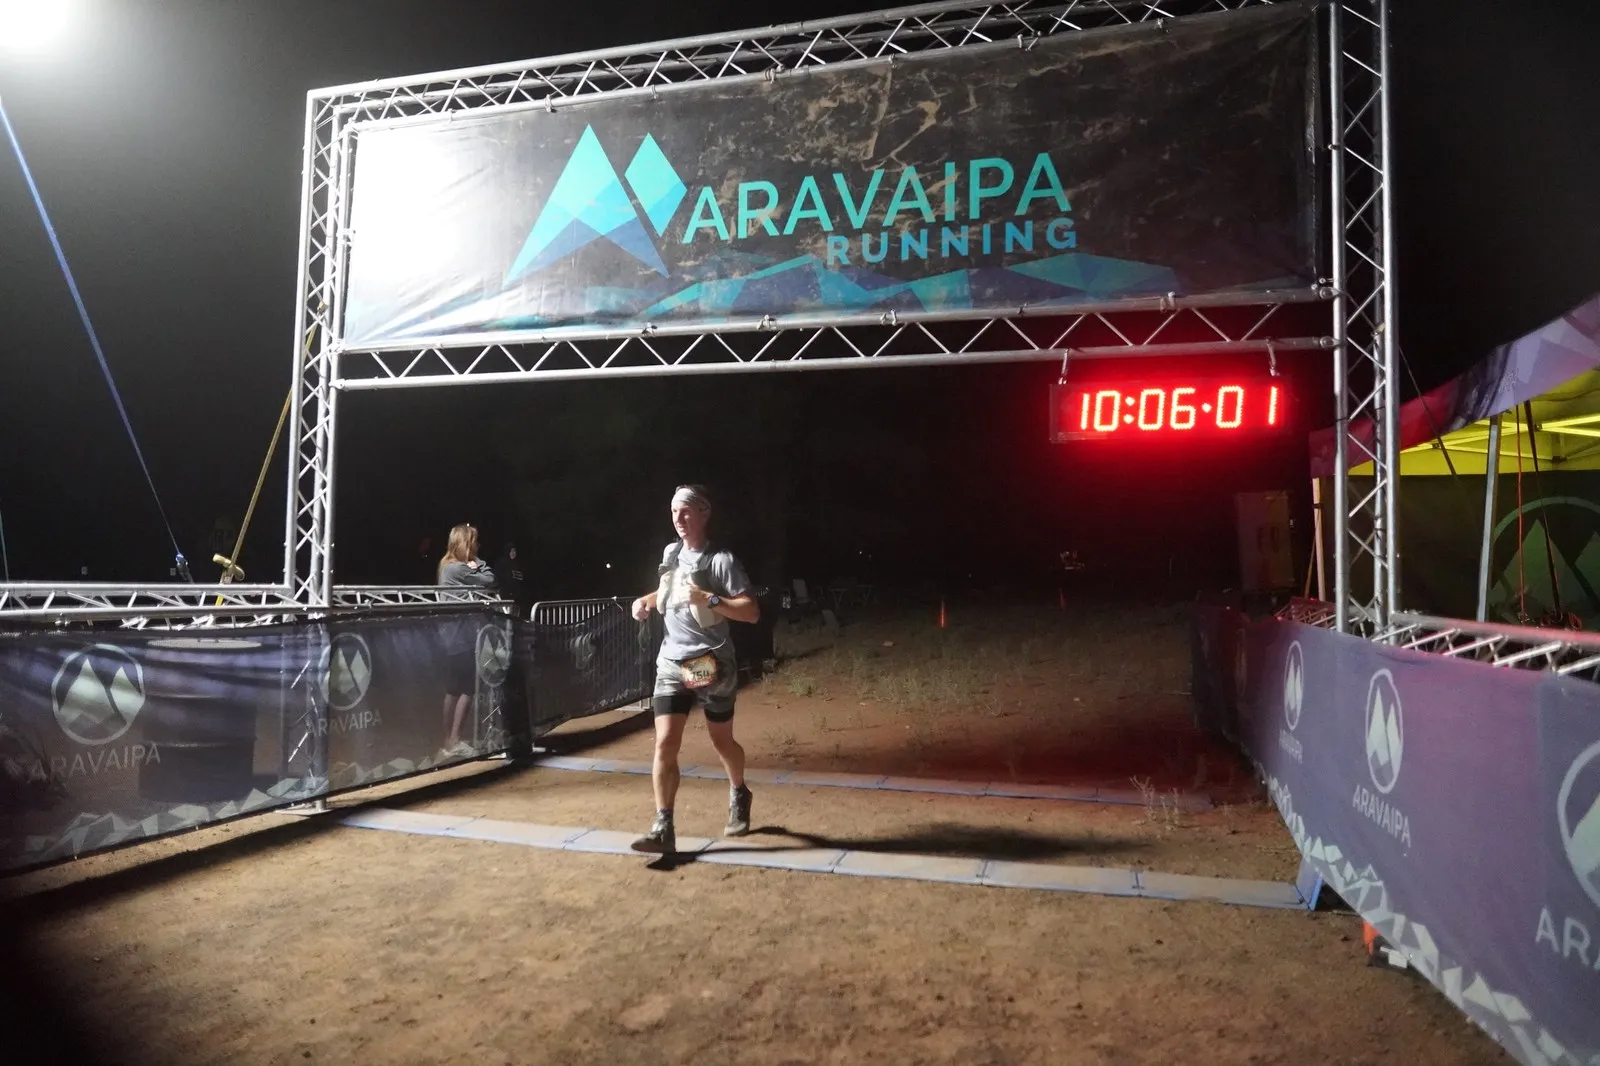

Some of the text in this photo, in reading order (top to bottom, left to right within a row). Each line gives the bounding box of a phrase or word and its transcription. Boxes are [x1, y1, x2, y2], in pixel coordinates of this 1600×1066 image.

[682, 152, 1071, 244] ARAVAIPA
[827, 217, 1078, 266] RUNNING
[1352, 784, 1411, 848] ARAVAIPA
[1535, 905, 1600, 970] AR
